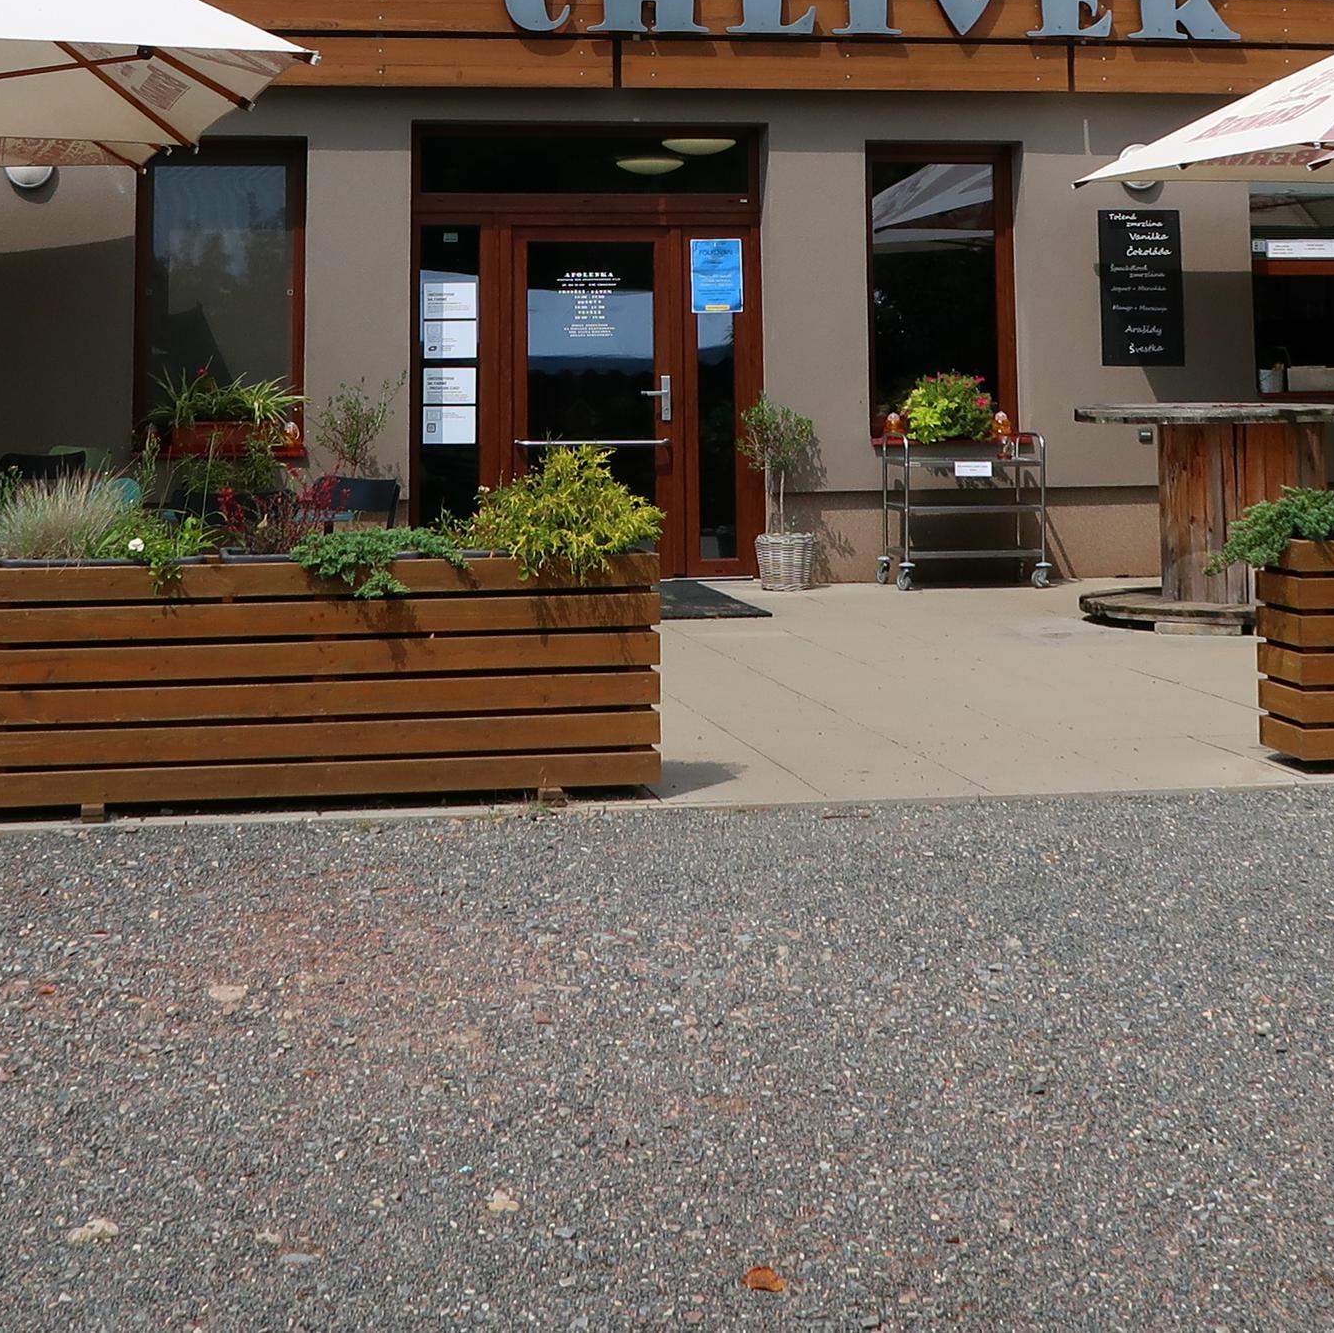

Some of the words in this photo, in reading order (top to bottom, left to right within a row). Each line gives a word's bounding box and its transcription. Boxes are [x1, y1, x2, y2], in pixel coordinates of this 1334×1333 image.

[1128, 232, 1170, 241] Vanilka
[1126, 245, 1173, 257] Čokoláda
[1124, 324, 1163, 336] Arašídy
[1128, 342, 1165, 354] Švestka
